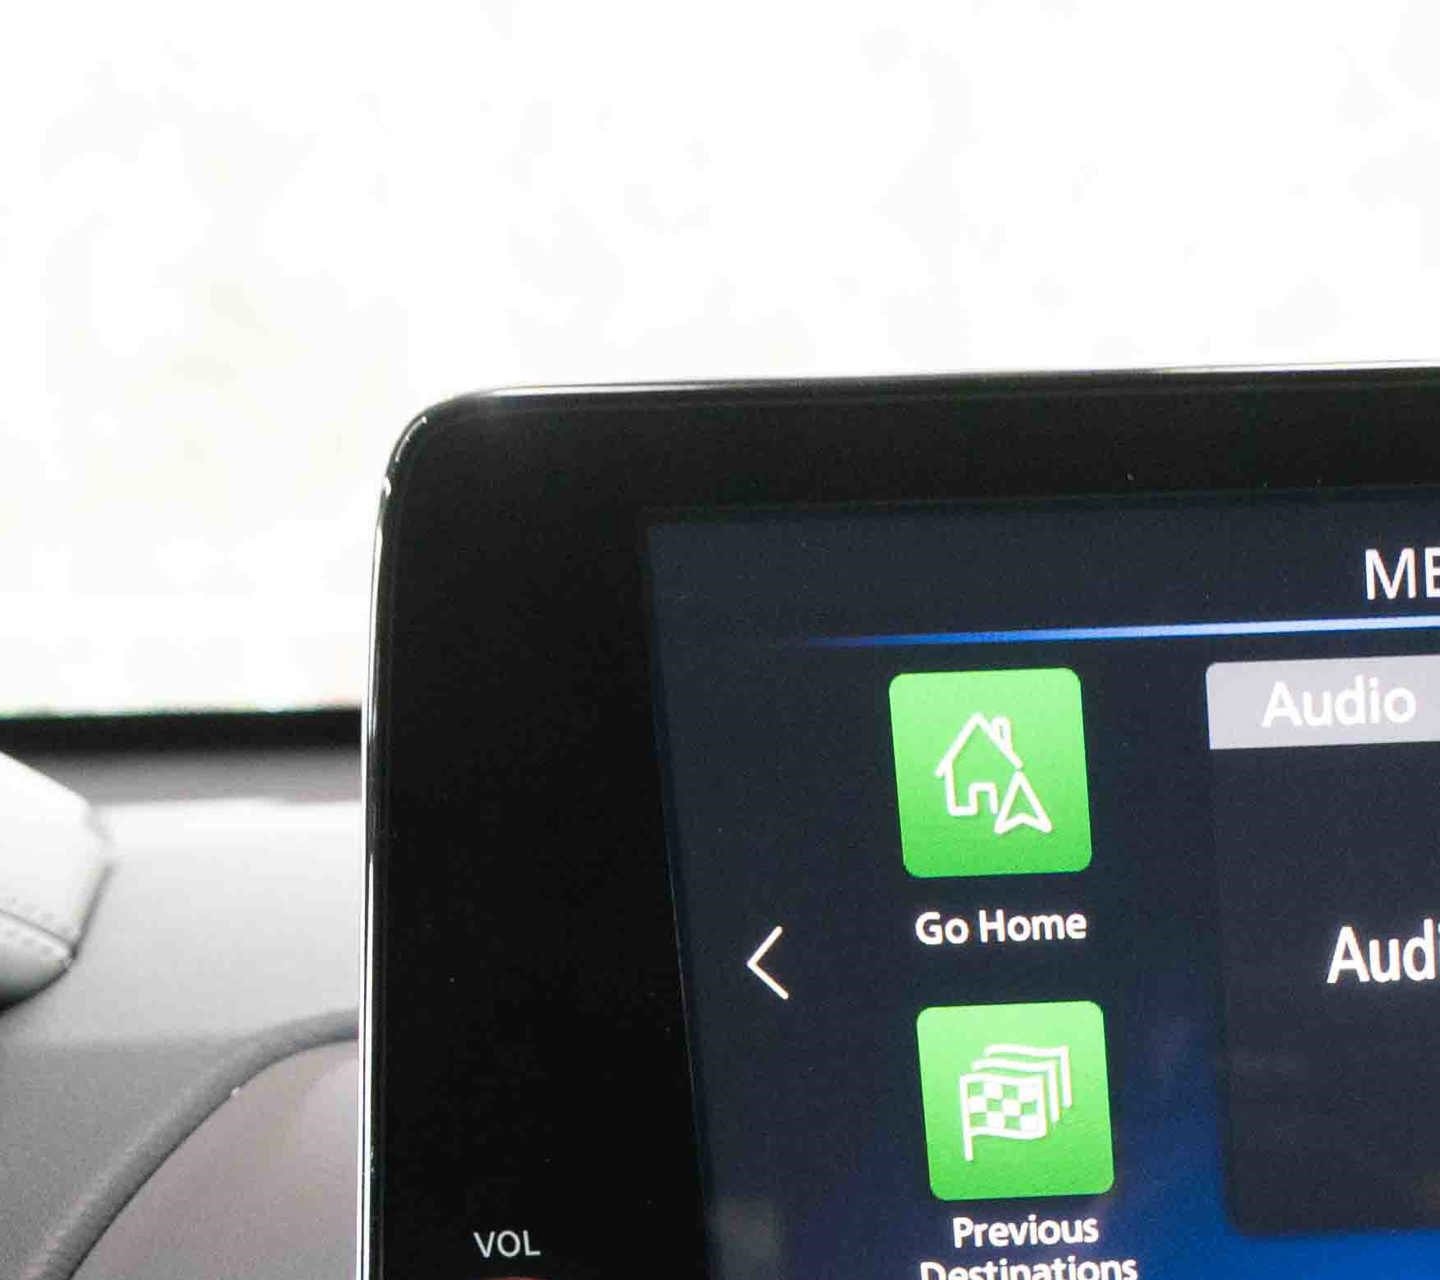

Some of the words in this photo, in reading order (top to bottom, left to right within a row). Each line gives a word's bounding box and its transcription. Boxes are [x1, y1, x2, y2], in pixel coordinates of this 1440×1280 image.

[1261, 674, 1417, 728] Audio
[914, 911, 969, 946] Go
[978, 908, 1087, 943] Home
[473, 1229, 541, 1258] VOL
[952, 1213, 1100, 1249] Previous
